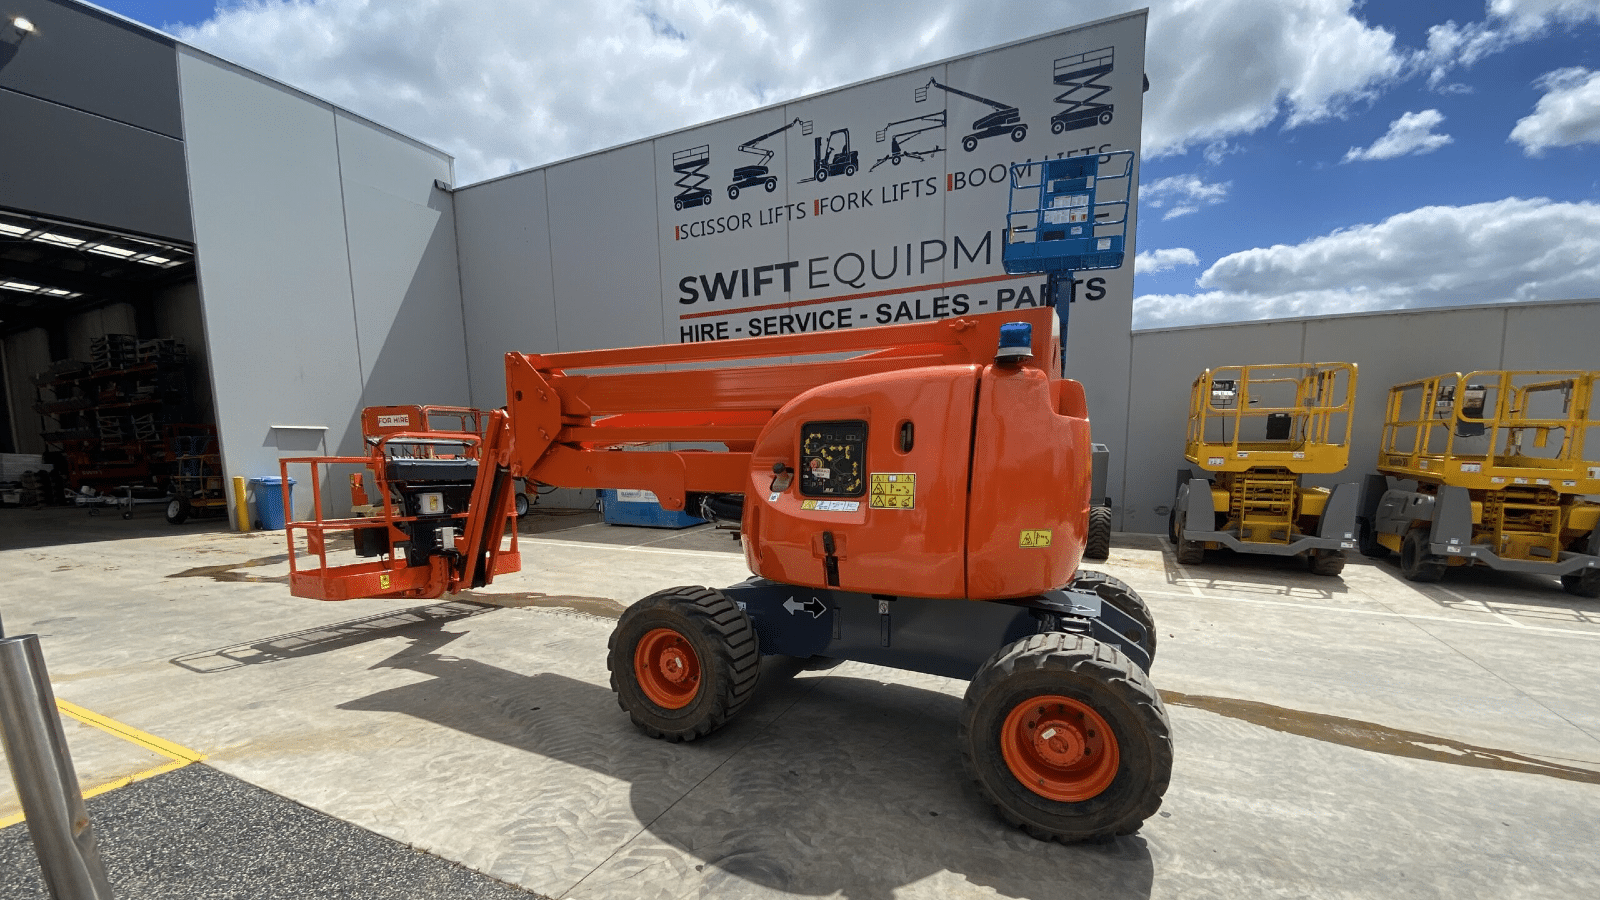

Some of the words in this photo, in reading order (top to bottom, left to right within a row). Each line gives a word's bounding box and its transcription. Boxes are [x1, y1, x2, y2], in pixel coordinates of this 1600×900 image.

[820, 188, 874, 215] FORK
[881, 176, 937, 204] LIFTS
[680, 212, 753, 240] SCISSOR
[759, 202, 806, 226] LIFTS
[679, 260, 799, 305] SWIFT
[808, 212, 1110, 289] EQUIPME
[680, 321, 730, 343] HIRE
[748, 307, 853, 337] SERVICE
[876, 293, 970, 324] SALES
